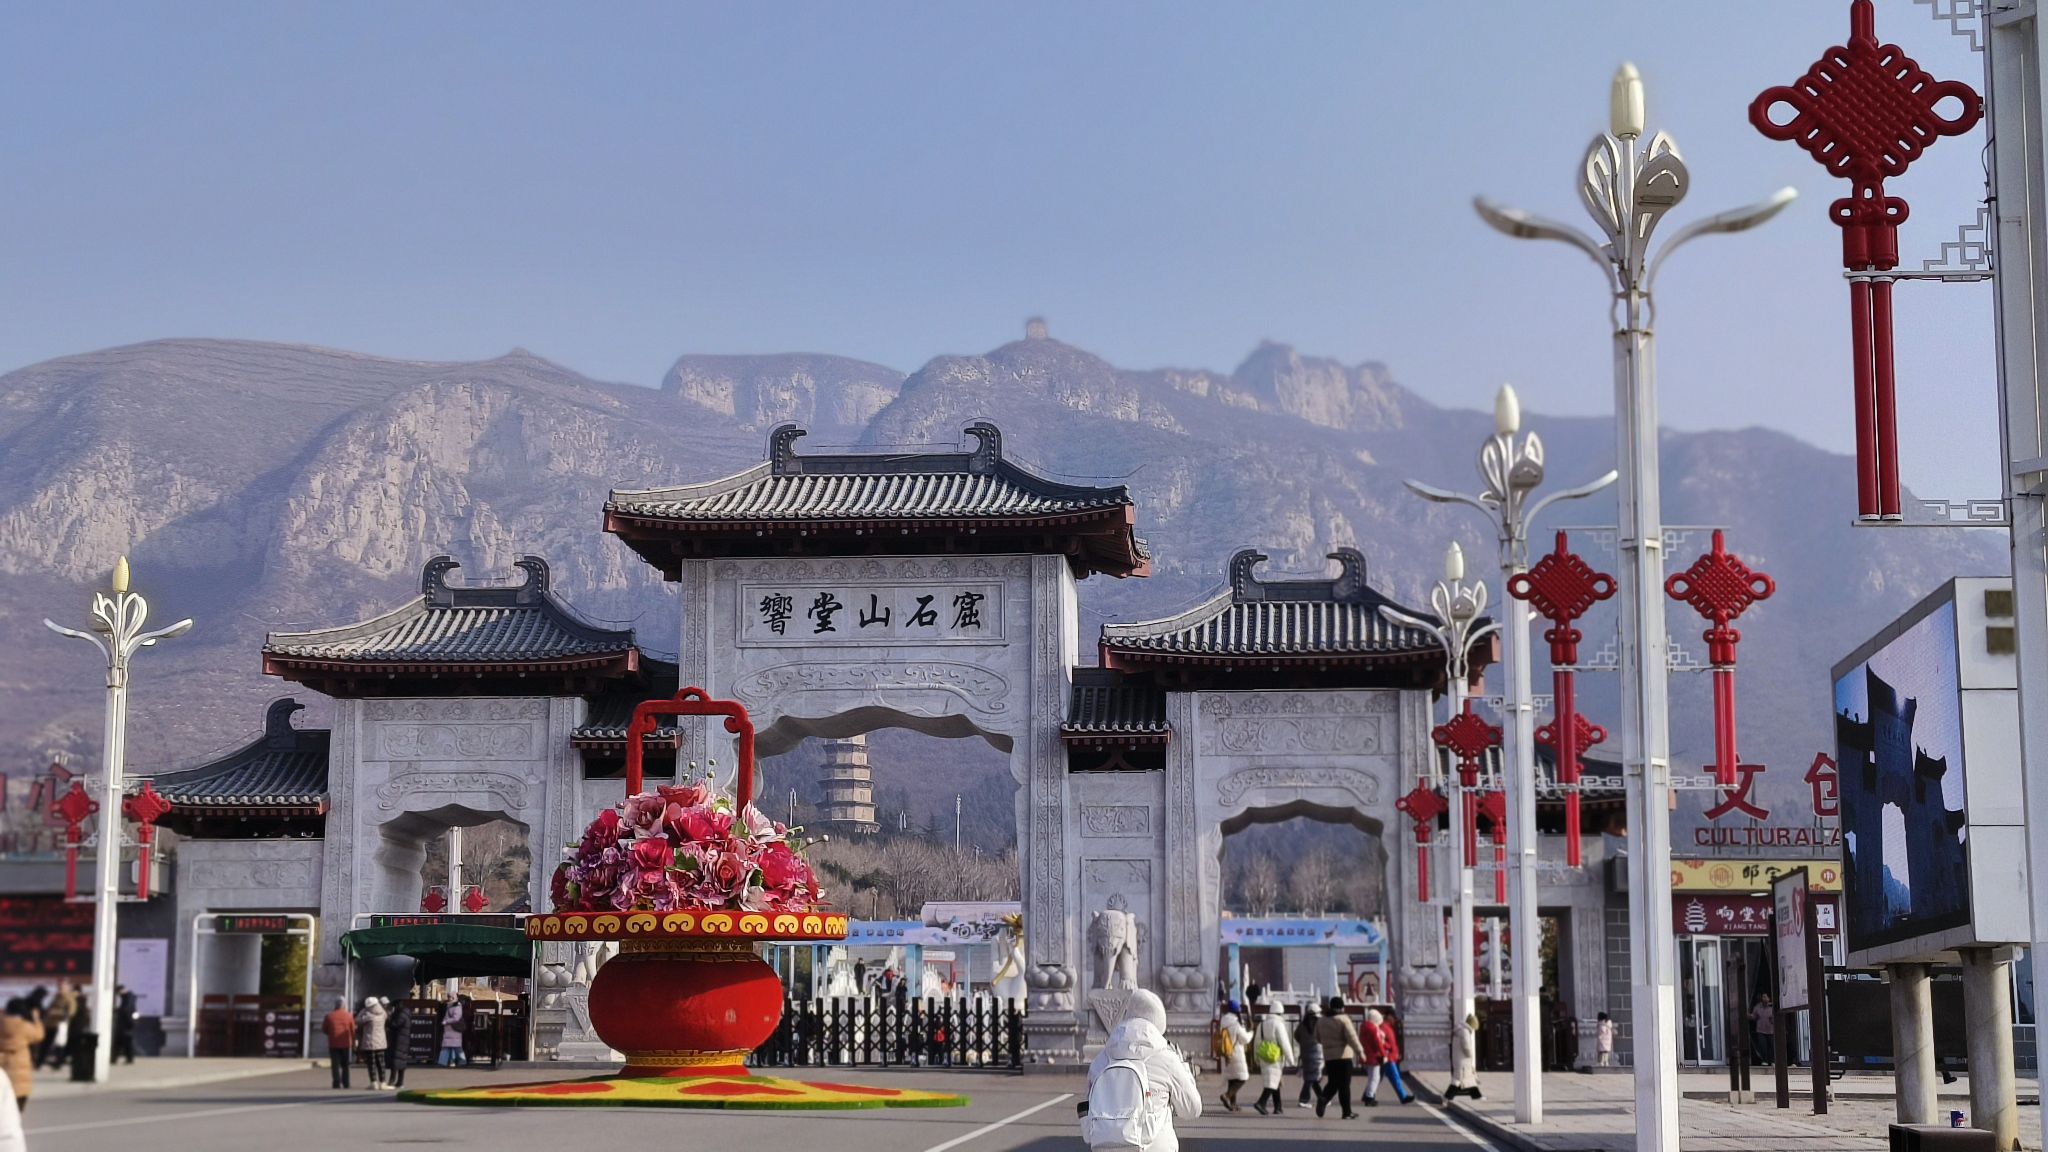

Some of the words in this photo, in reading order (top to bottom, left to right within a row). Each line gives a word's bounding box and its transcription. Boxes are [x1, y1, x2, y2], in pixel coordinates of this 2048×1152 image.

[760, 591, 984, 636] 響堂山石窟
[1694, 827, 1825, 846] CULTURAL
